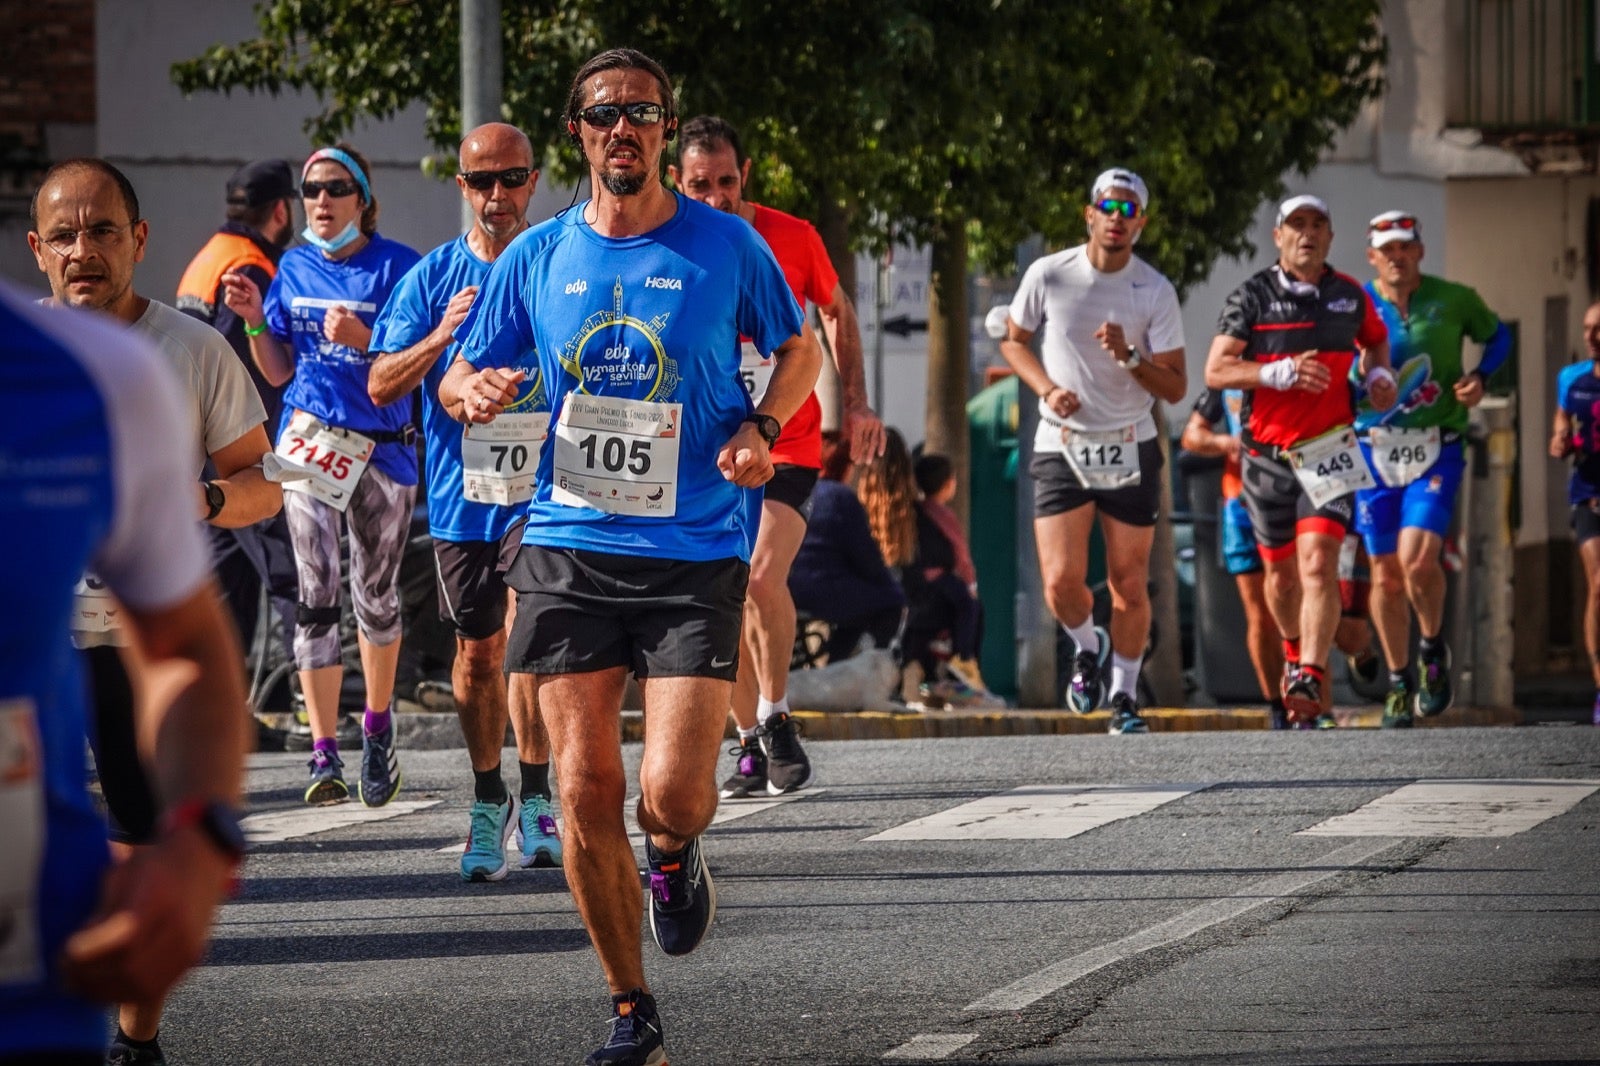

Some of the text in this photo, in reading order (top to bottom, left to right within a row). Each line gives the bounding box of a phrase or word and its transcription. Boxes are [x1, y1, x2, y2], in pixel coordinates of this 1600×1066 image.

[565, 279, 587, 296] edp
[645, 277, 682, 290] HOKA
[604, 343, 630, 362] edp
[599, 361, 646, 373] maratón
[610, 369, 647, 381] sevilla
[490, 445, 528, 472] 70
[580, 434, 651, 475] 105
[1081, 445, 1123, 466] 112
[1317, 451, 1354, 477] 449
[1388, 445, 1427, 464] 496
